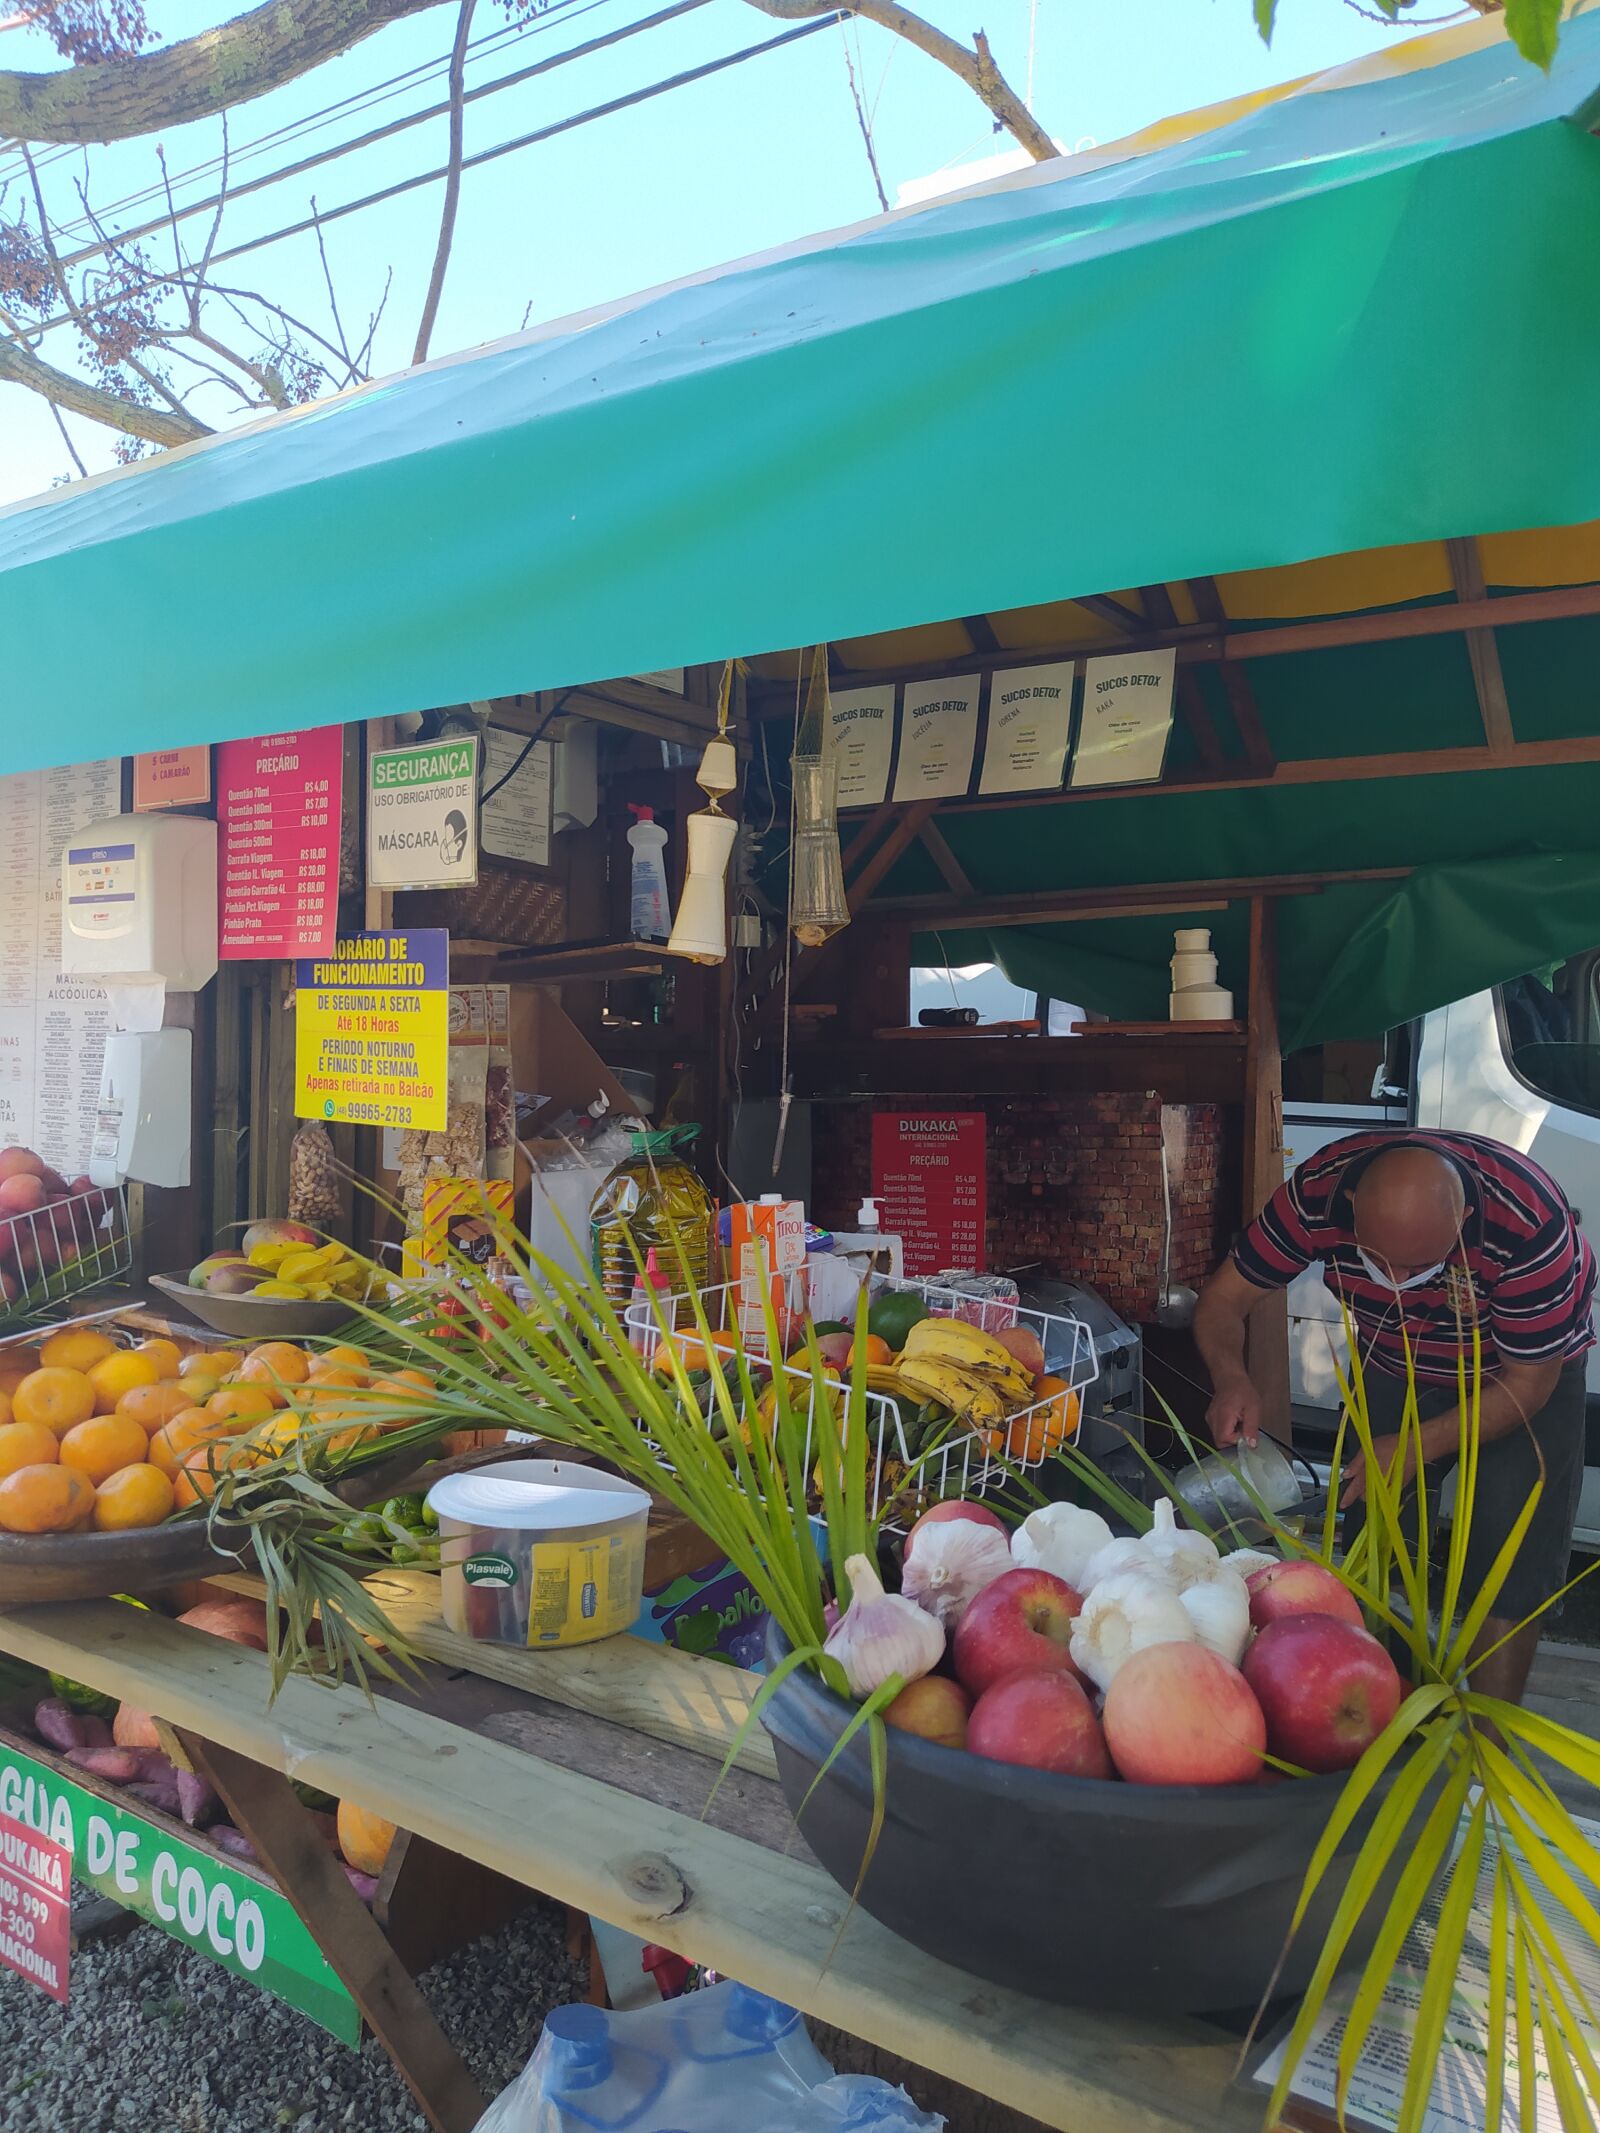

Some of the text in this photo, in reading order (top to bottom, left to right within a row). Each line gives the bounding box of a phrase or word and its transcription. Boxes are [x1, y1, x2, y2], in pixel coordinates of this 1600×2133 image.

[1096, 675, 1161, 694] SUCOS DETOX
[1001, 687, 1061, 705] SUCOS DETOX
[832, 708, 884, 725] SUCOS DETOX
[912, 701, 968, 719] SUCOS DETOX
[256, 753, 299, 776] PREÇÁRIO
[375, 751, 470, 784] SEGURANÇA
[228, 789, 253, 801] Quentão
[254, 786, 270, 798] 70ml
[374, 783, 471, 807] USO OBRIGATÓRIO DE:
[228, 806, 253, 817] Quentão
[228, 821, 253, 833] Quentão
[228, 837, 253, 849] Quentão
[378, 829, 440, 851] MÁSCARA
[227, 853, 250, 865] Garrafa
[250, 852, 273, 865] Viagem
[227, 870, 252, 881] Quentão
[261, 868, 284, 880] Viagem
[226, 886, 251, 898] Quentão
[251, 885, 279, 896] Garrafão
[225, 902, 246, 913] Pinhão
[224, 918, 245, 929] Pinhão
[245, 917, 262, 928] Prato
[222, 934, 255, 945] Amendoim
[389, 938, 408, 960] DE
[313, 962, 425, 986] FUNCIONAMENTO
[317, 994, 421, 1012] DE SEGUNDA A SEXTA
[336, 1015, 399, 1033] Até 18 Horas
[322, 1036, 415, 1058] PERÍODO NOTURNO
[318, 1057, 419, 1078] E FINAIS DE SEMANA
[306, 1074, 434, 1099] Apenas retirada no Balcão
[347, 1102, 412, 1124] 99965-2783
[899, 1116, 958, 1132] DUKAKÁ
[899, 1133, 960, 1141] INTERNACIONAL
[910, 1153, 950, 1168] PREÇÁRIO
[776, 1220, 804, 1239] TIROL
[466, 1563, 510, 1575] Plasvale
[0, 1766, 265, 1971] GUA DE COCO
[23, 1892, 49, 1925] 999
[0, 1905, 35, 1944] -300
[0, 1931, 59, 1990] NACIONAL
